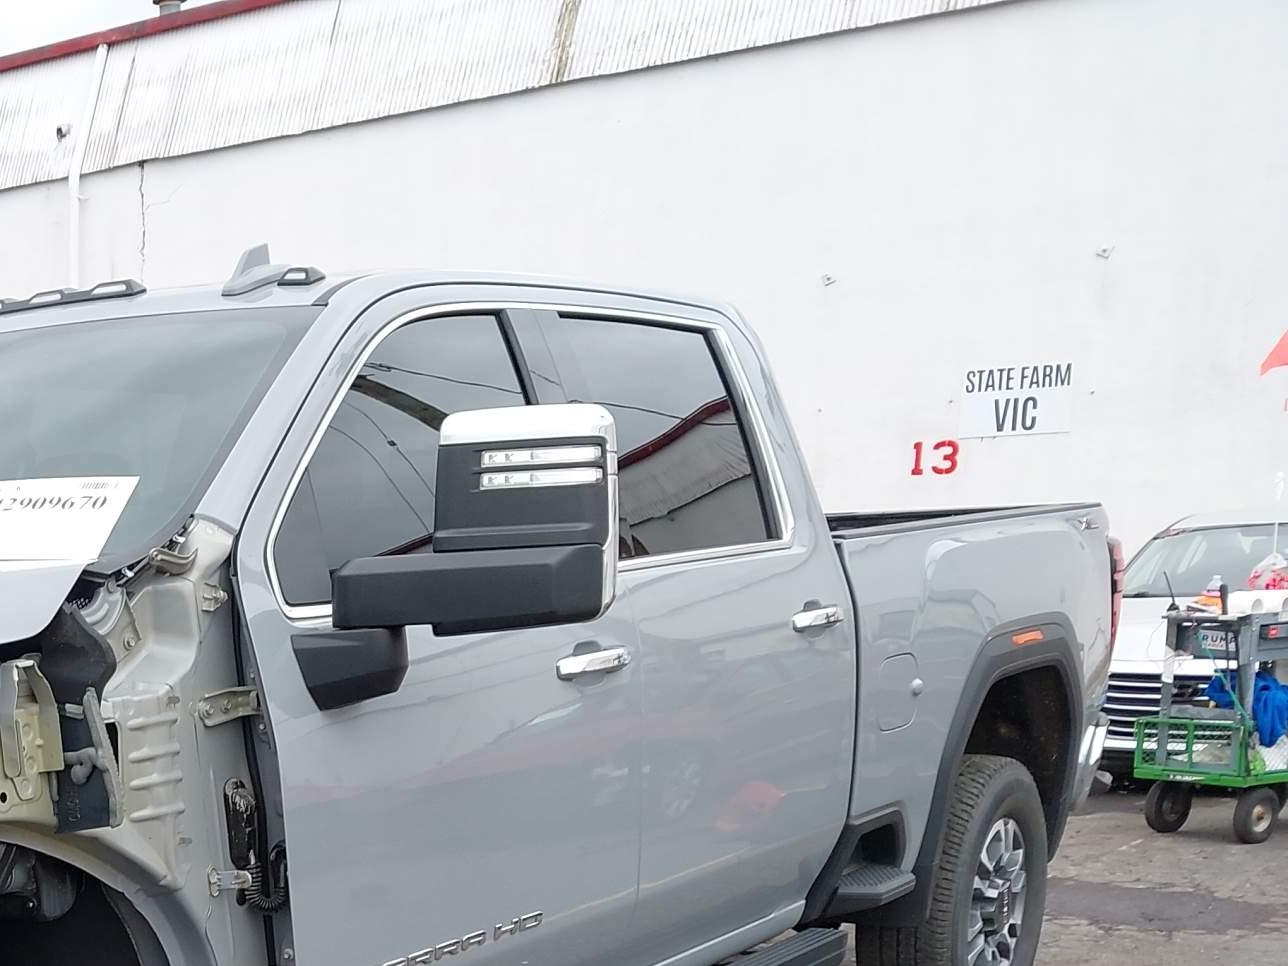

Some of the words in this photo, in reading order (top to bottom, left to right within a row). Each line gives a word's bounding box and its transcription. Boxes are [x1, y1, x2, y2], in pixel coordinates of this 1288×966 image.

[965, 367, 1015, 393] STATE
[1019, 362, 1073, 390] FARM
[994, 396, 1038, 432] VIC
[911, 439, 960, 476] 13
[493, 910, 544, 942] HD
